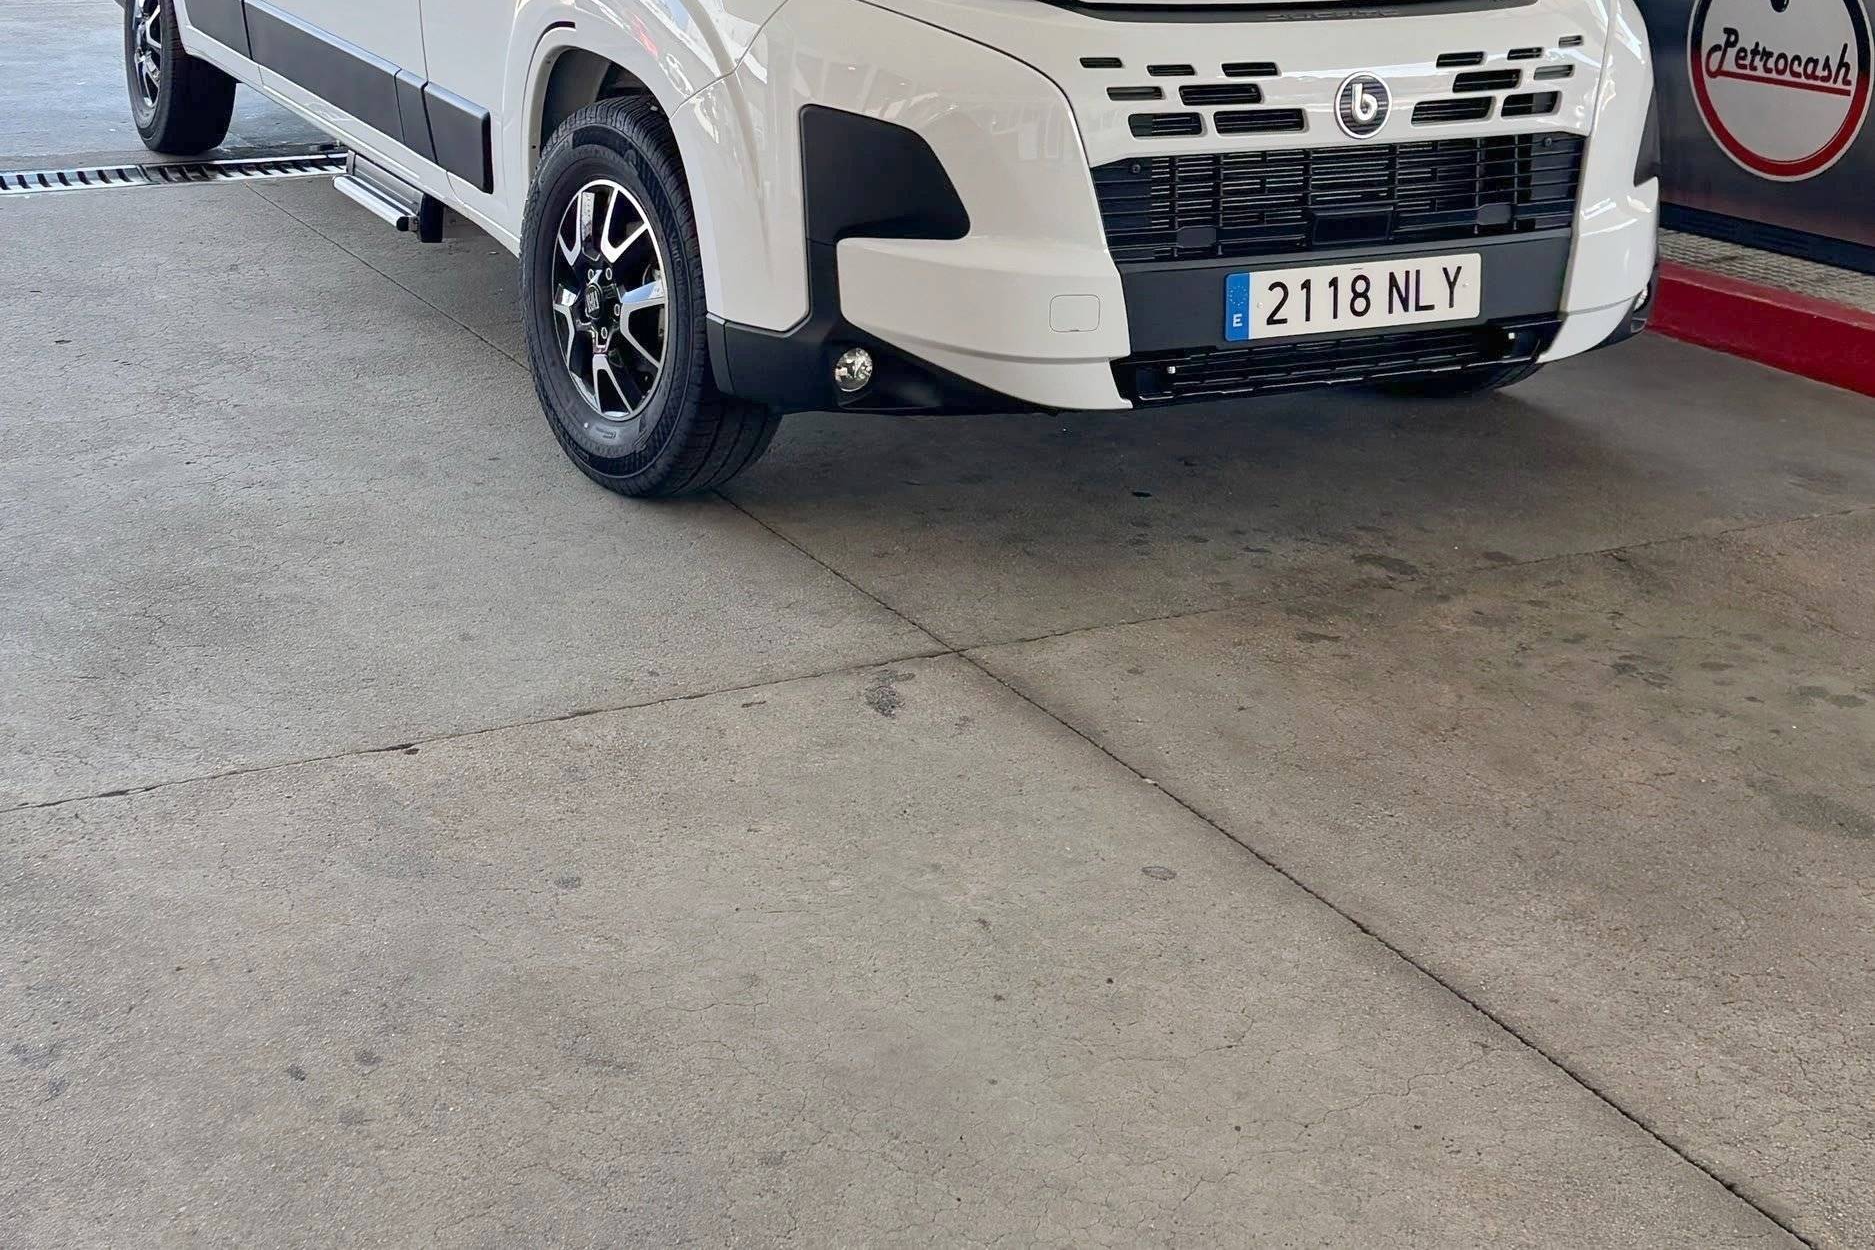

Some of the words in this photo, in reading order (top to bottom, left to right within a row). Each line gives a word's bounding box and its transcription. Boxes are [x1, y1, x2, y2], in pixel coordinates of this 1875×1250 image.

[1706, 27, 1852, 86] Petrocash
[1232, 314, 1243, 327] E
[1266, 275, 1371, 326] 2118
[1388, 266, 1462, 314] NLY
